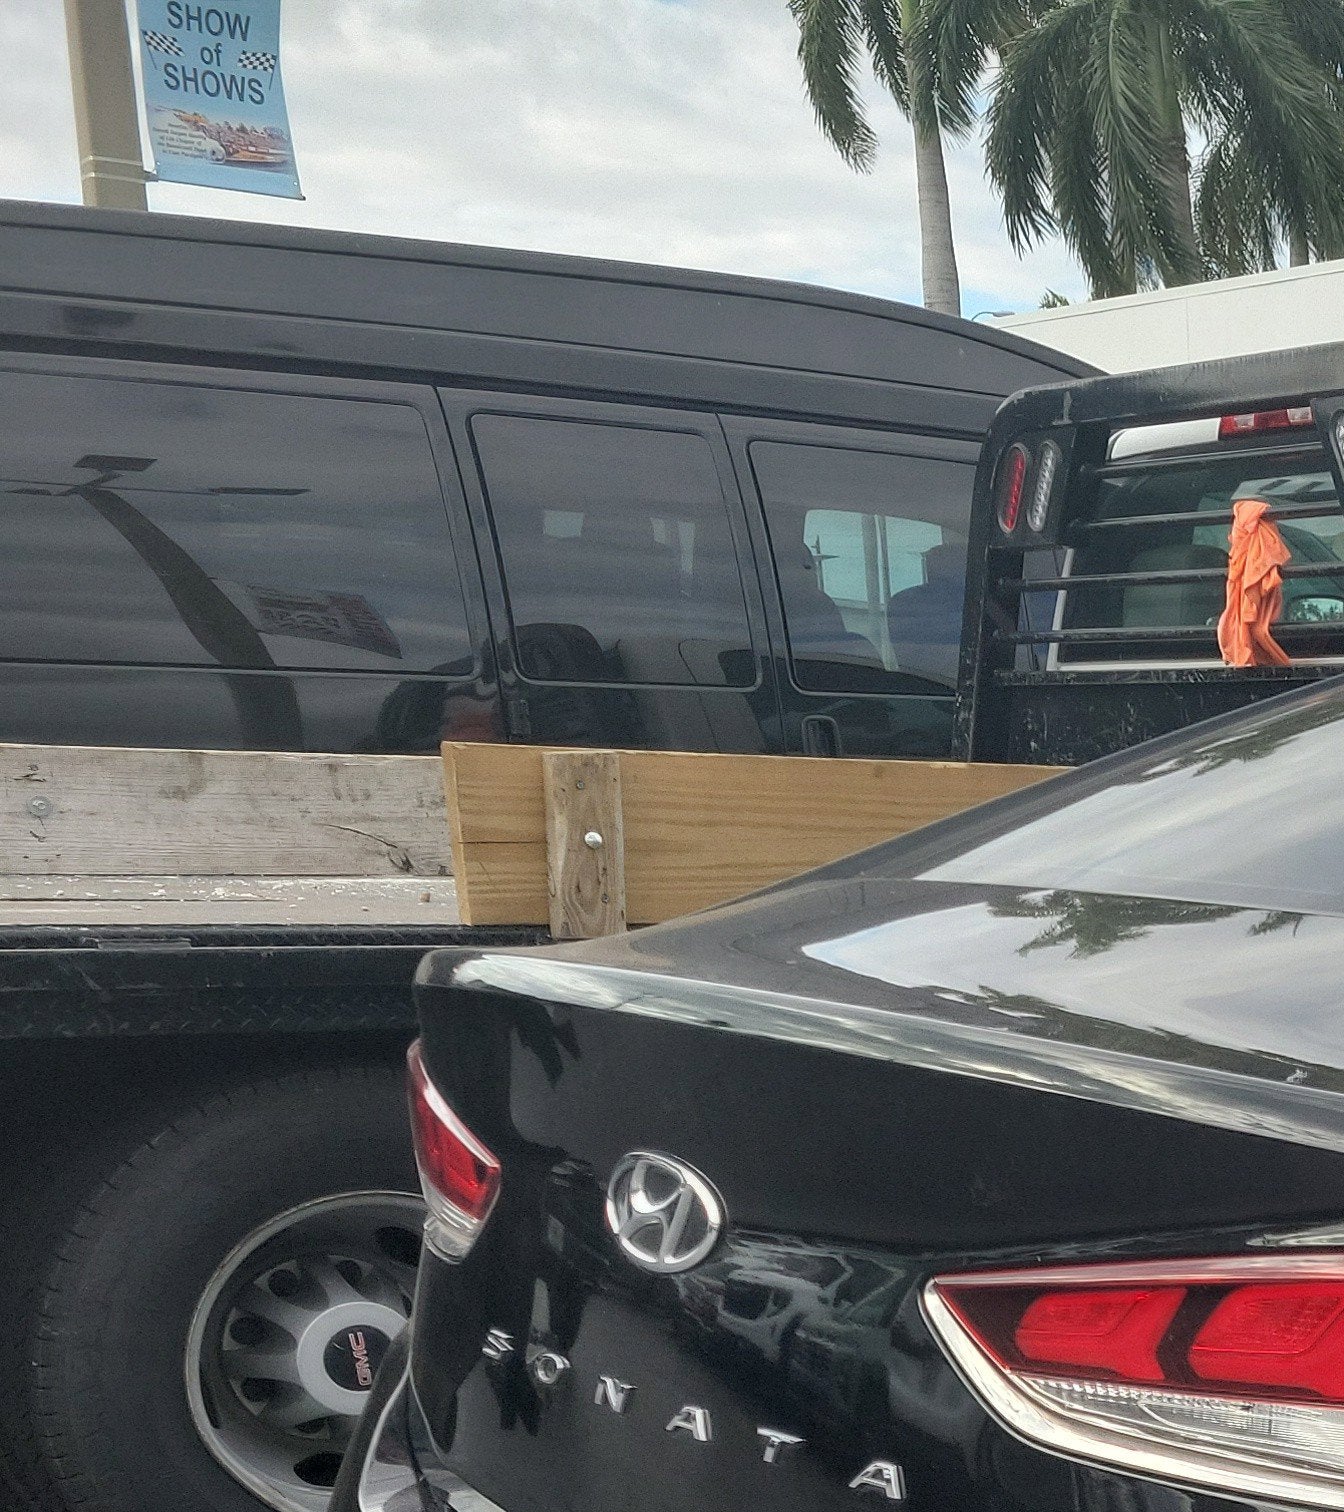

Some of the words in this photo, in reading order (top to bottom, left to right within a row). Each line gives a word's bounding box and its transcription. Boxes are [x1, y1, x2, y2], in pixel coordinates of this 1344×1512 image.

[166, 1, 250, 42] SHOW
[200, 42, 222, 66] of
[163, 62, 265, 105] SHOWS
[348, 1331, 373, 1386] GMC
[481, 1328, 908, 1500] SONATA
